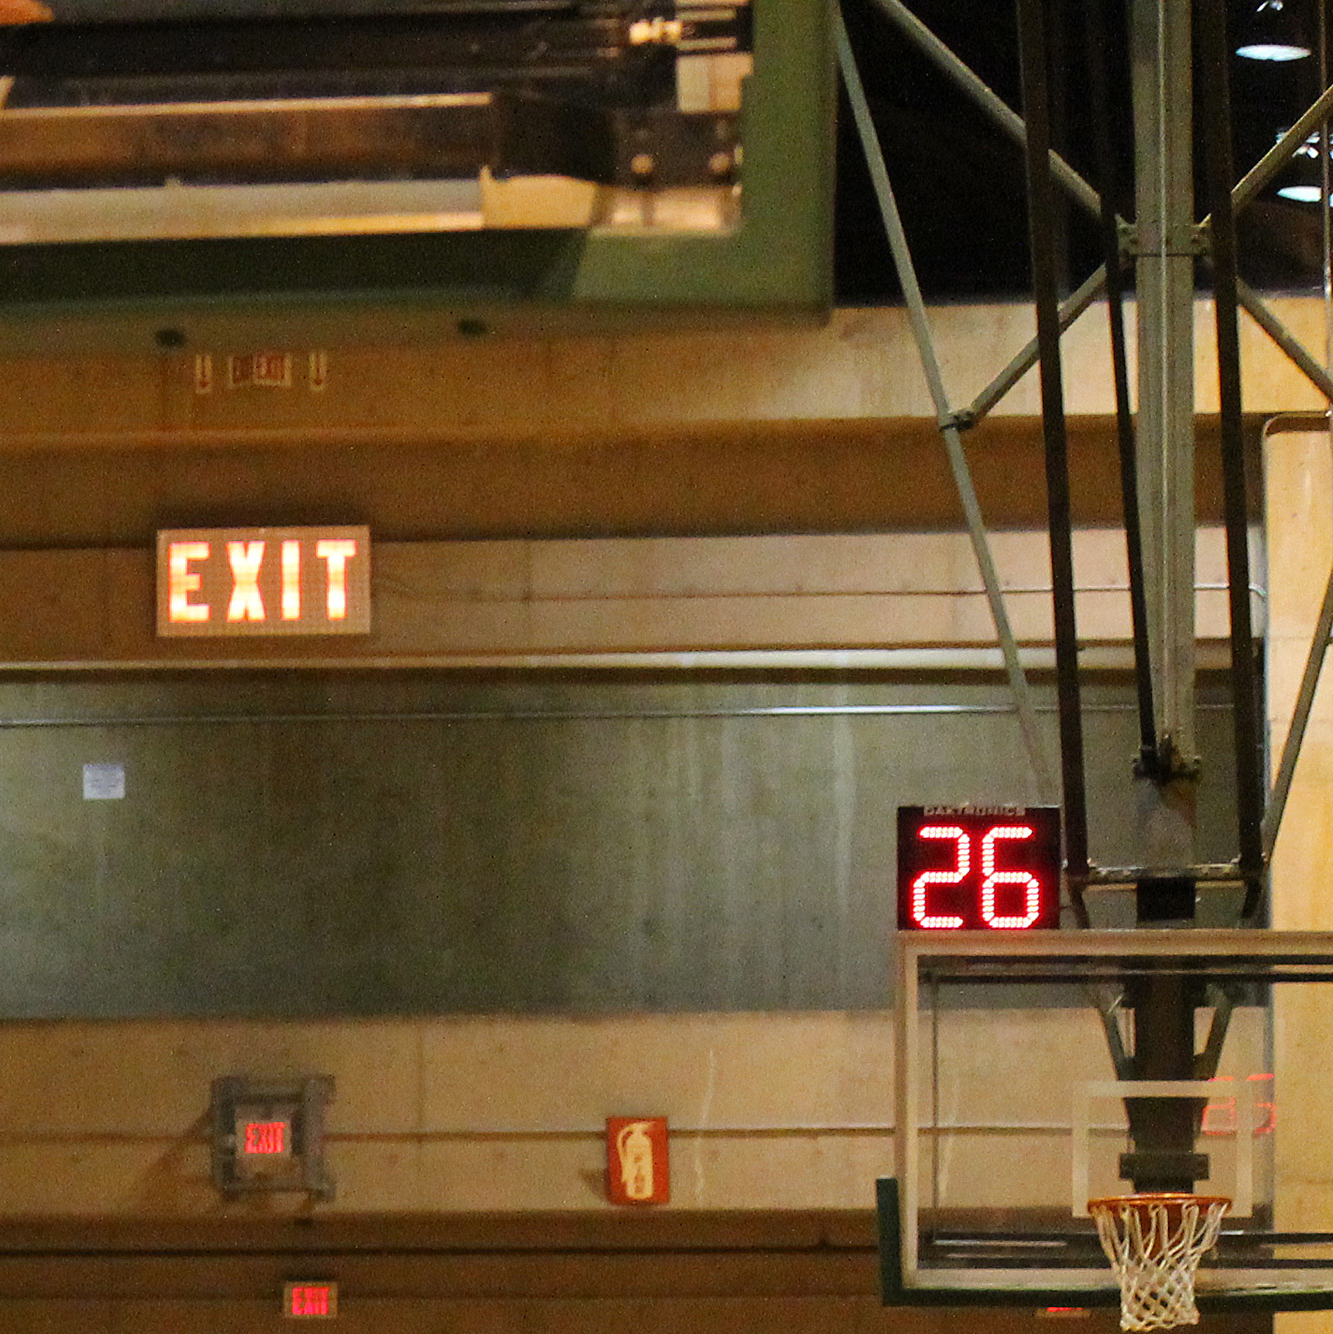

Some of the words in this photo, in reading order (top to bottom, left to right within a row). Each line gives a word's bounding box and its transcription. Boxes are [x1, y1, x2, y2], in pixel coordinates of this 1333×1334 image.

[168, 539, 357, 623] EXIT
[911, 825, 1041, 929] 26
[245, 1122, 285, 1153] EXIT
[291, 1286, 331, 1315] EXIT
